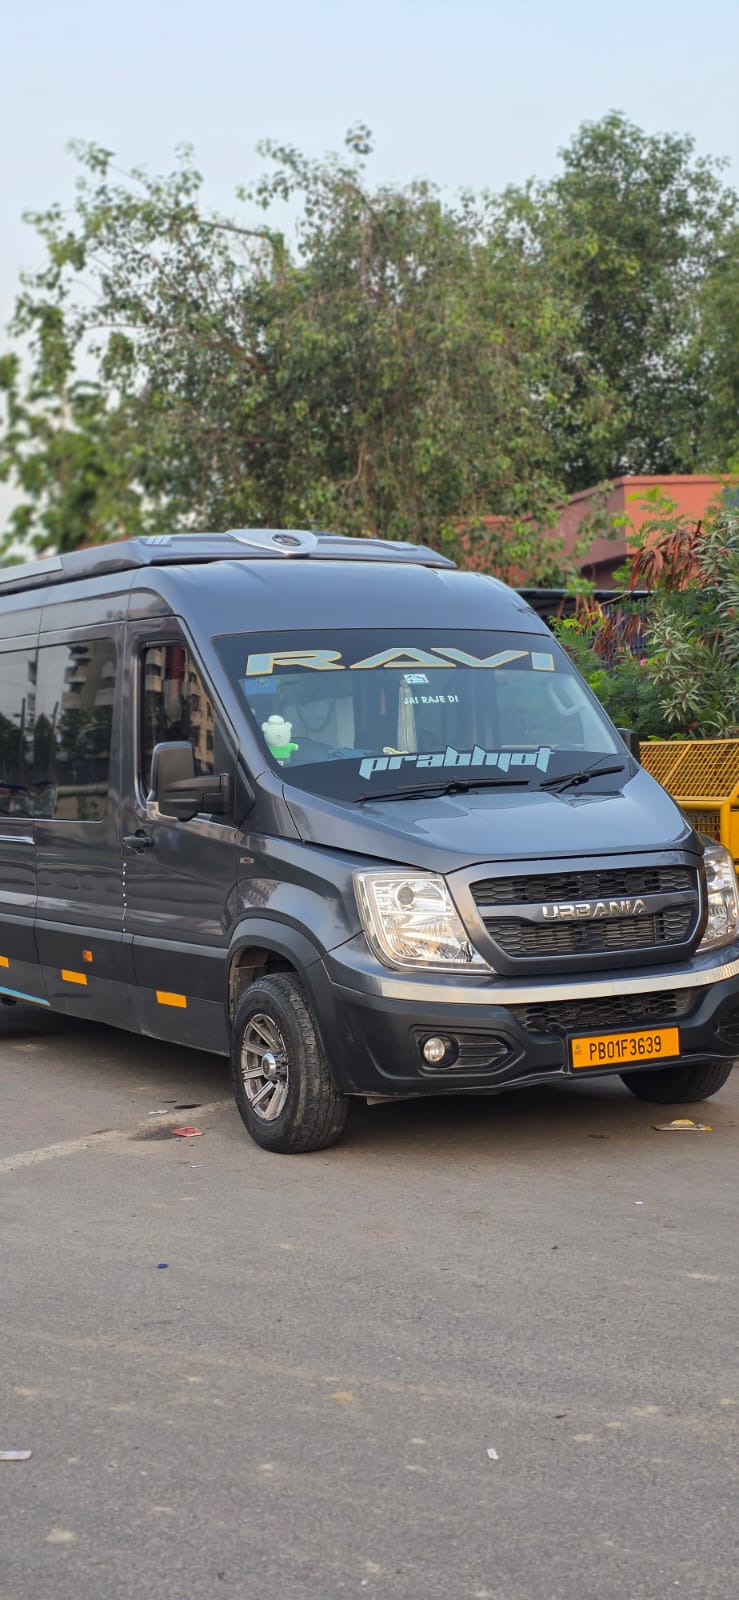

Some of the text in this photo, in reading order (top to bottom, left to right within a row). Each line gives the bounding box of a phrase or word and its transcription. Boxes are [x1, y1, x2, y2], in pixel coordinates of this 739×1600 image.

[245, 647, 555, 676] RAVI
[403, 696, 419, 705] JAI
[421, 695, 446, 704] RAJE
[358, 745, 556, 780] prabhjot
[542, 899, 648, 919] URBANIA
[589, 1035, 662, 1061] PB01F3639
